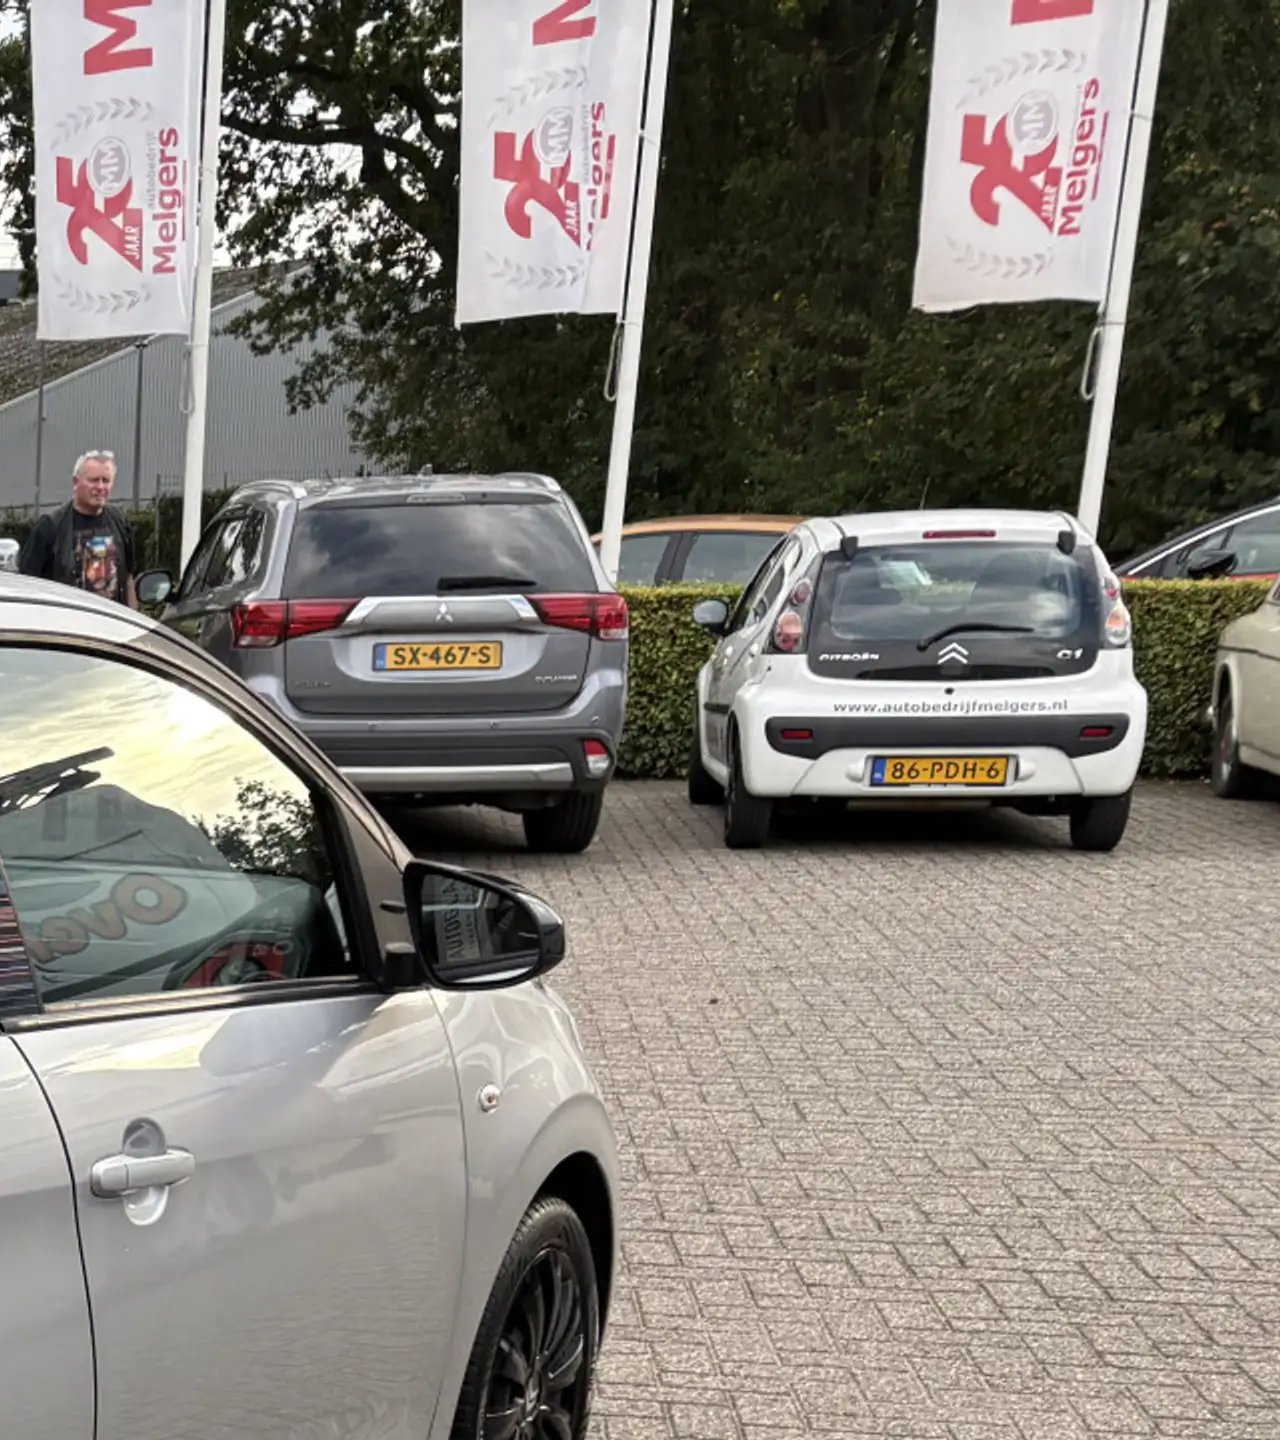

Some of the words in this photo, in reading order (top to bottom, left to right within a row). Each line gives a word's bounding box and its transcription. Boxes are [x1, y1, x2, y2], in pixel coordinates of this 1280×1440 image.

[1058, 78, 1100, 236] Melgers
[152, 127, 183, 274] Melgers
[123, 225, 141, 260] JAAR
[393, 646, 491, 666] SX-467-S
[833, 700, 1069, 714] www.autobedrijfmelgers.nl
[890, 761, 1002, 780] 86-PDH-6
